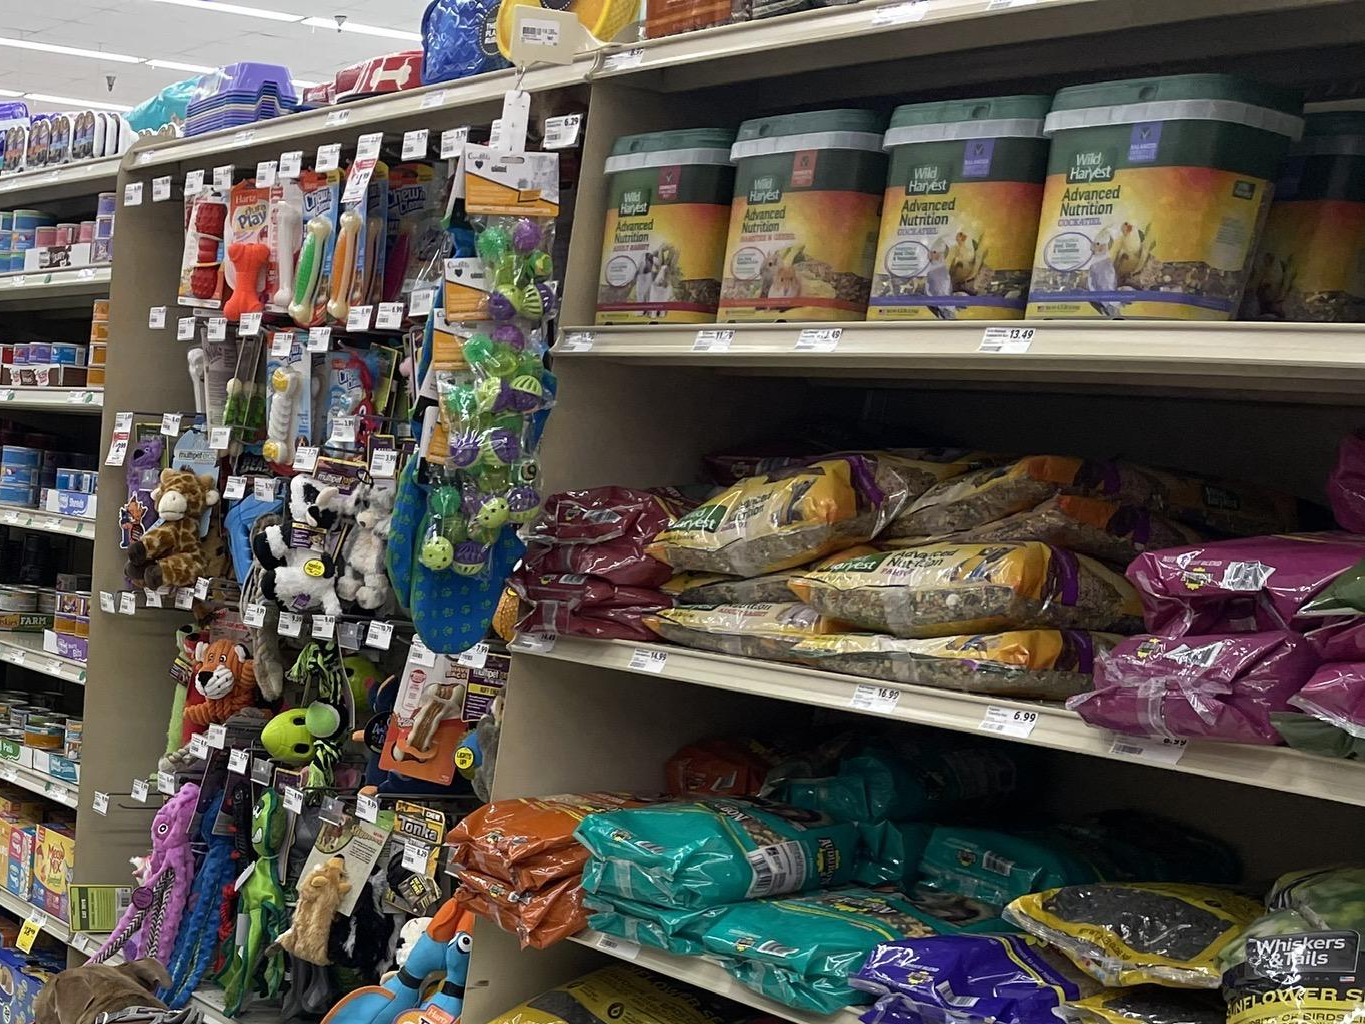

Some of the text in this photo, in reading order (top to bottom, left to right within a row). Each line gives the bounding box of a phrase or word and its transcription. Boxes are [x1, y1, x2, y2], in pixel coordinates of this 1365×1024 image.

[564, 117, 579, 128] 6.29
[1076, 151, 1102, 165] Wild
[914, 165, 937, 179] Wild
[1070, 164, 1111, 182] Harvest
[754, 176, 773, 190] Wild
[909, 177, 947, 194] Harvest
[624, 190, 641, 203] Wild
[749, 188, 780, 203] Harvest
[1061, 185, 1121, 202] Advanced
[619, 201, 648, 216] Harvest
[901, 197, 956, 213] Advanced
[1060, 201, 1114, 217] Nutrition
[238, 208, 267, 231] Play
[744, 205, 786, 221] Advanced
[615, 218, 654, 233] Advanced
[741, 220, 780, 234] Nutrition
[899, 213, 949, 228] Nutrition
[615, 231, 650, 244] Nutrition
[1009, 329, 1034, 341] 13.49
[20, 615, 47, 627] FARM
[650, 652, 667, 662] 14.99
[878, 688, 900, 701] 16.99
[1014, 711, 1037, 723] 6.99
[398, 814, 438, 842] Tonka
[1256, 936, 1346, 956] Whiskers
[1303, 1013, 1345, 1022] BIRDS
